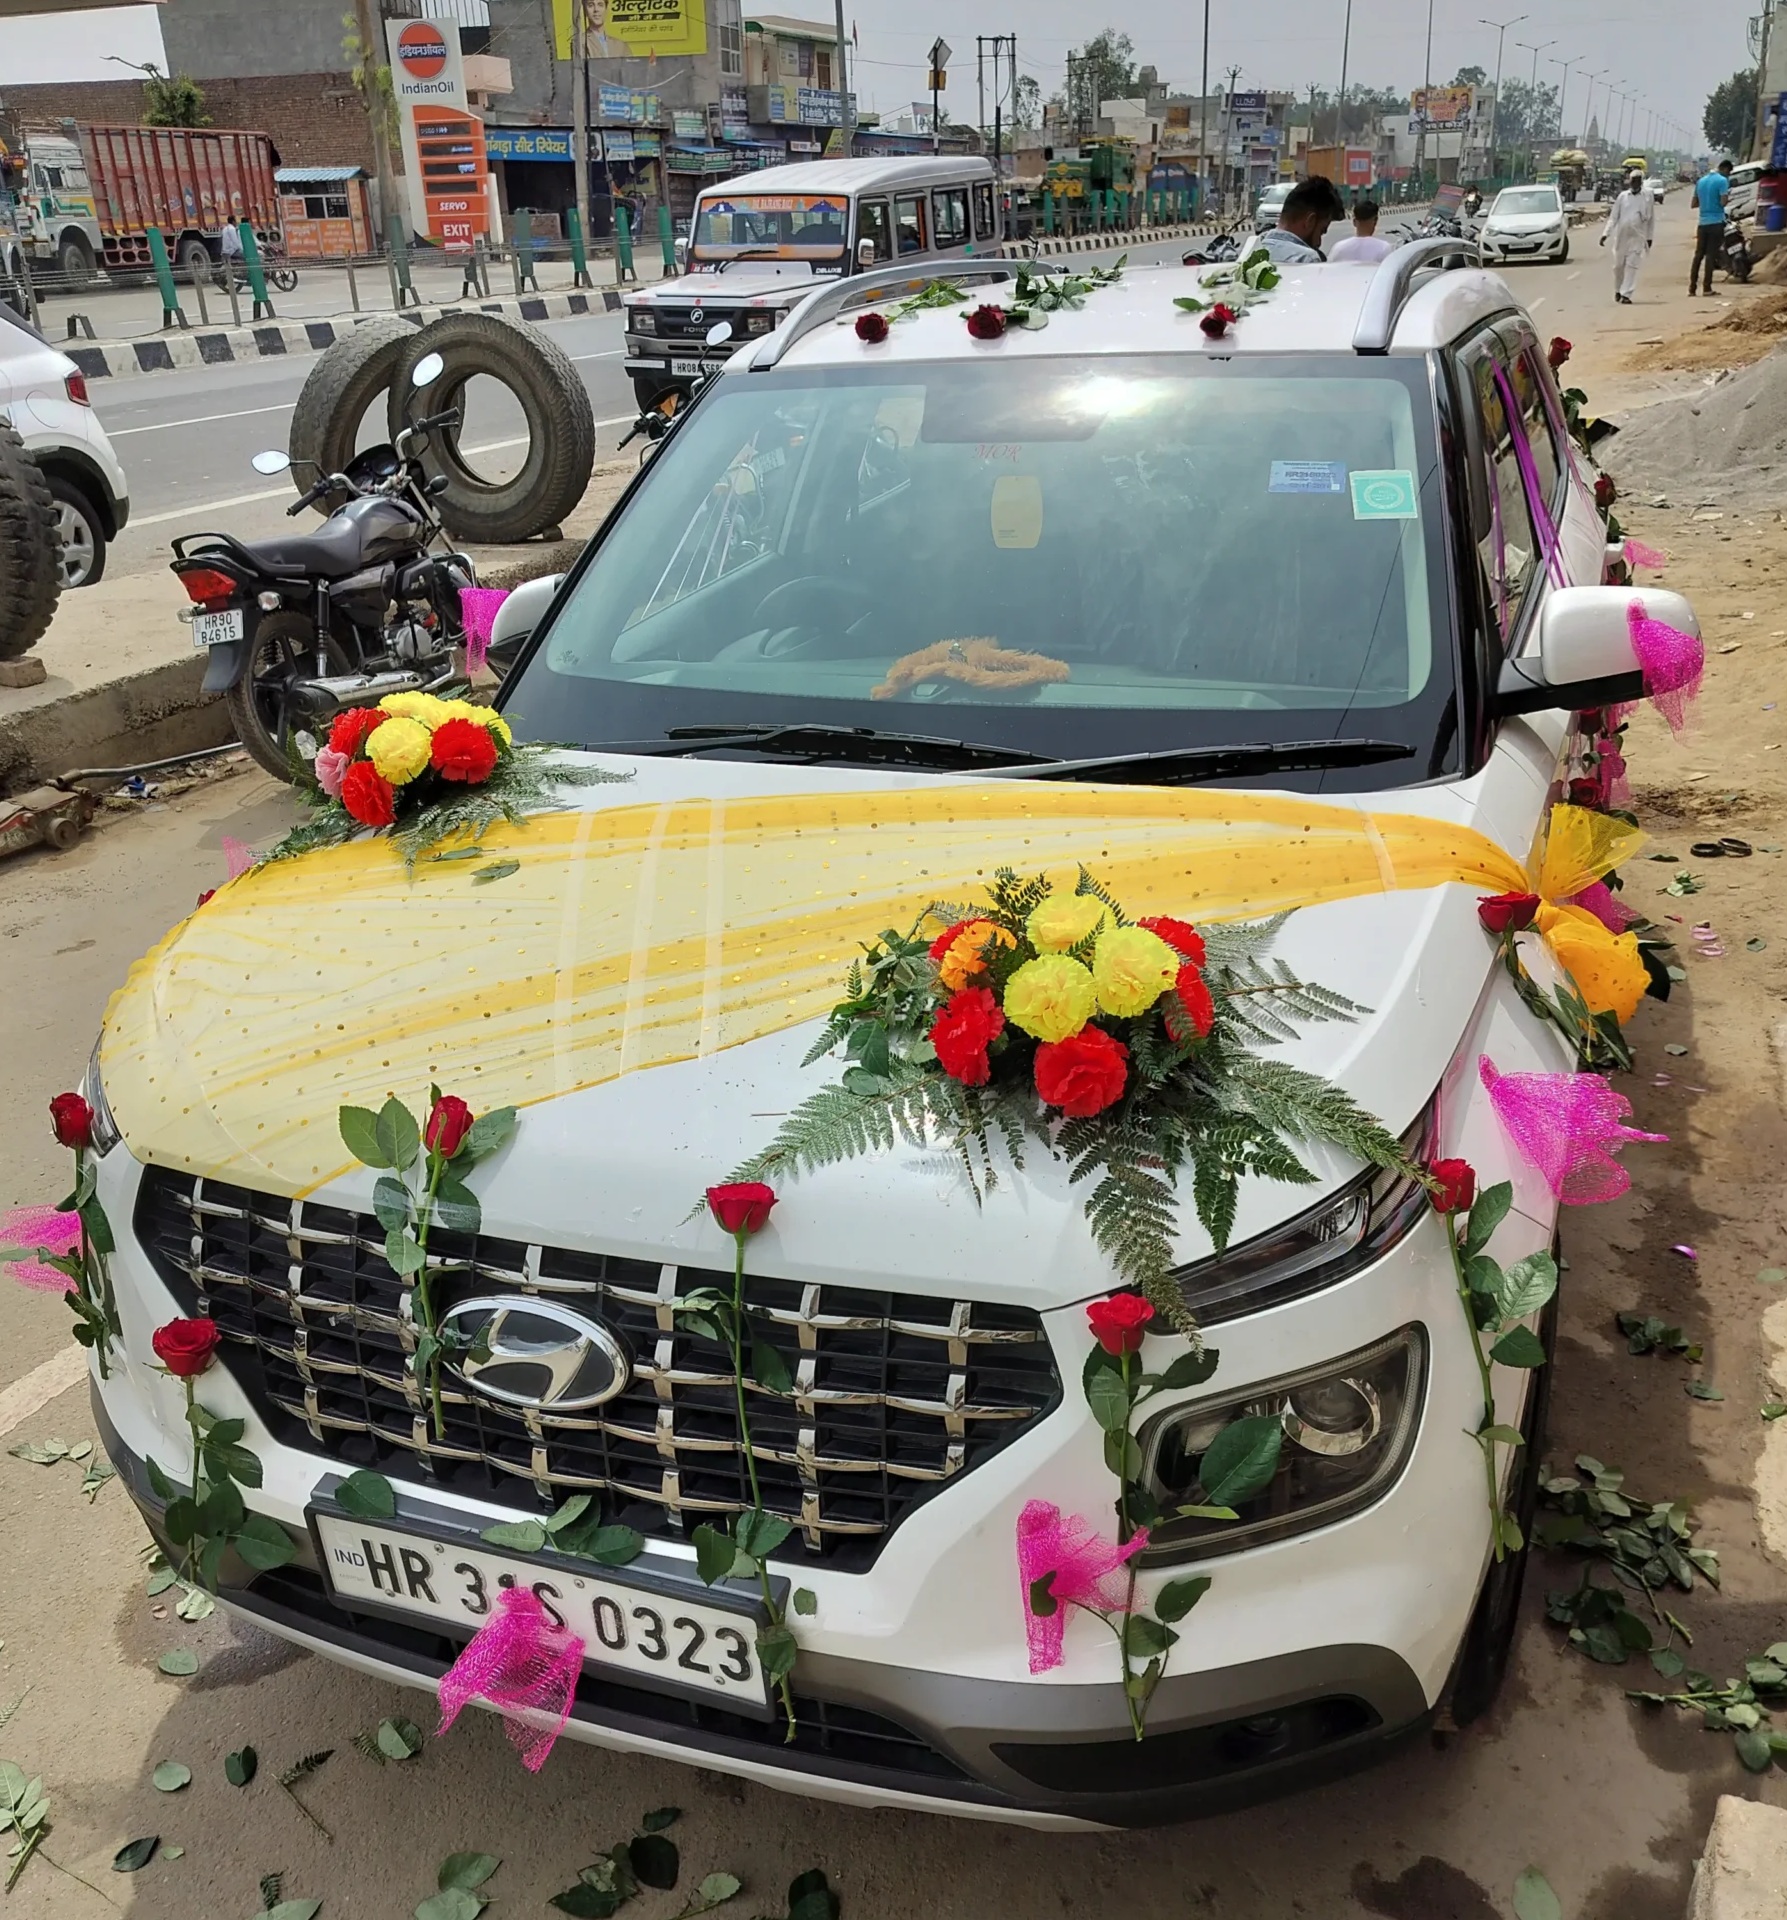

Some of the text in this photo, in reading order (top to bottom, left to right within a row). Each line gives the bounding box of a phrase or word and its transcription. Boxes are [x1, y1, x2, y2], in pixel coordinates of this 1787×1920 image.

[399, 44, 446, 58] इंडियनऑयल
[401, 81, 454, 94] IndianOil
[514, 136, 534, 153] सीट
[536, 136, 567, 154] रिपेयर
[439, 201, 468, 211] SERVO
[443, 223, 470, 237] EXIT
[815, 266, 843, 274] DELUXE
[205, 612, 232, 630] HR90
[201, 626, 236, 644] B4615
[334, 1548, 365, 1567] IND
[360, 1538, 440, 1604] HR
[593, 1595, 753, 1682] 0323
